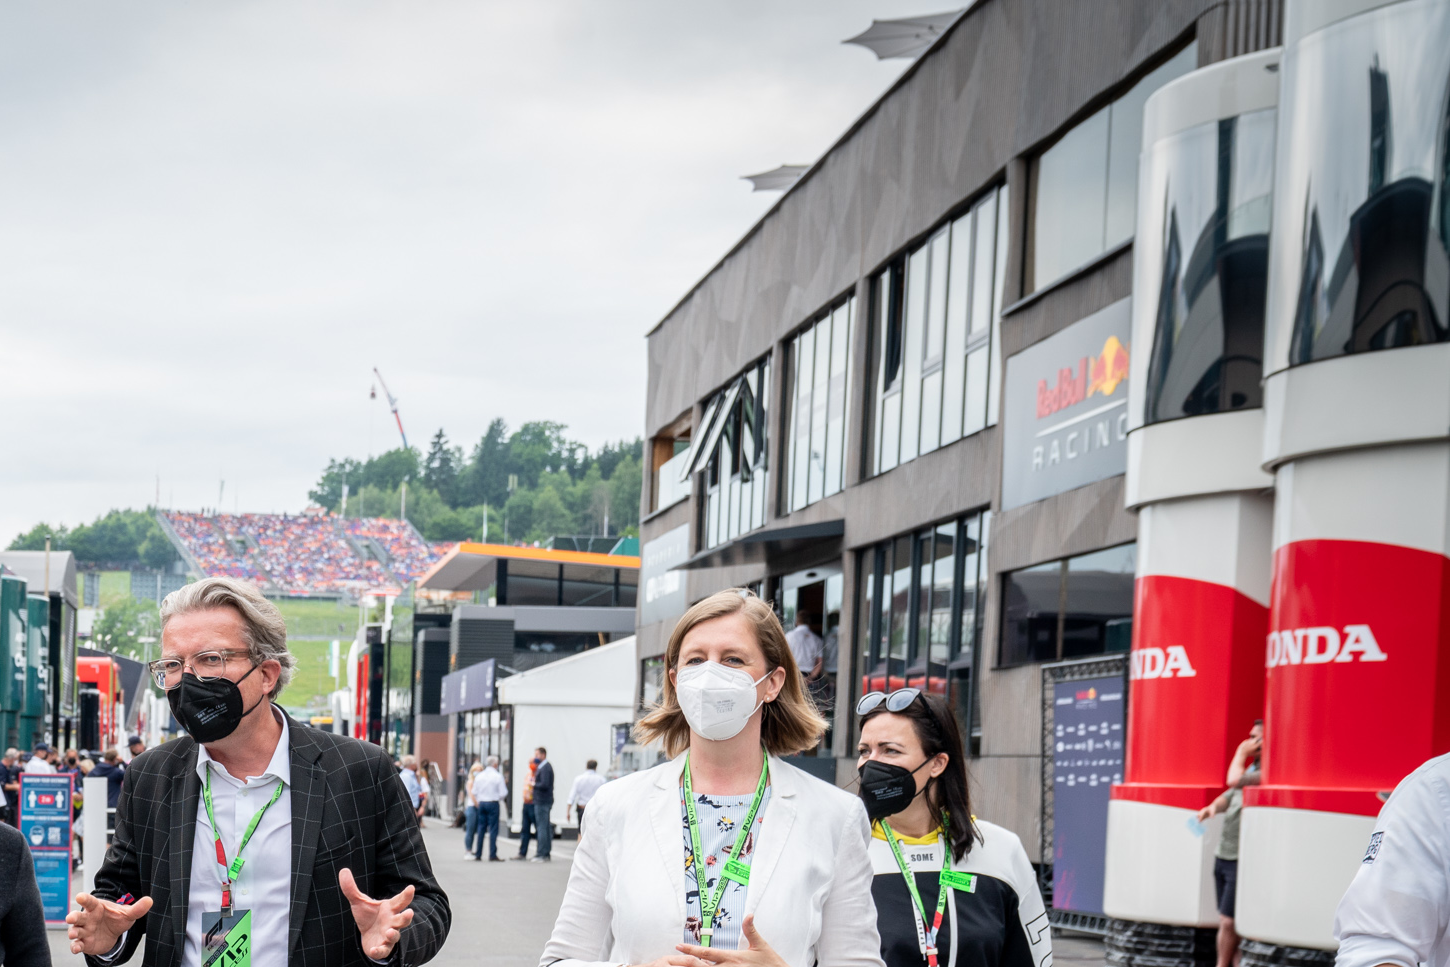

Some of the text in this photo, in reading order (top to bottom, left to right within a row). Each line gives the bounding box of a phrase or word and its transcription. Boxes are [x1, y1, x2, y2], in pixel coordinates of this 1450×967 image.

[1130, 645, 1197, 681] NDA
[1266, 623, 1388, 669] ONDA
[910, 853, 934, 862] SOME
